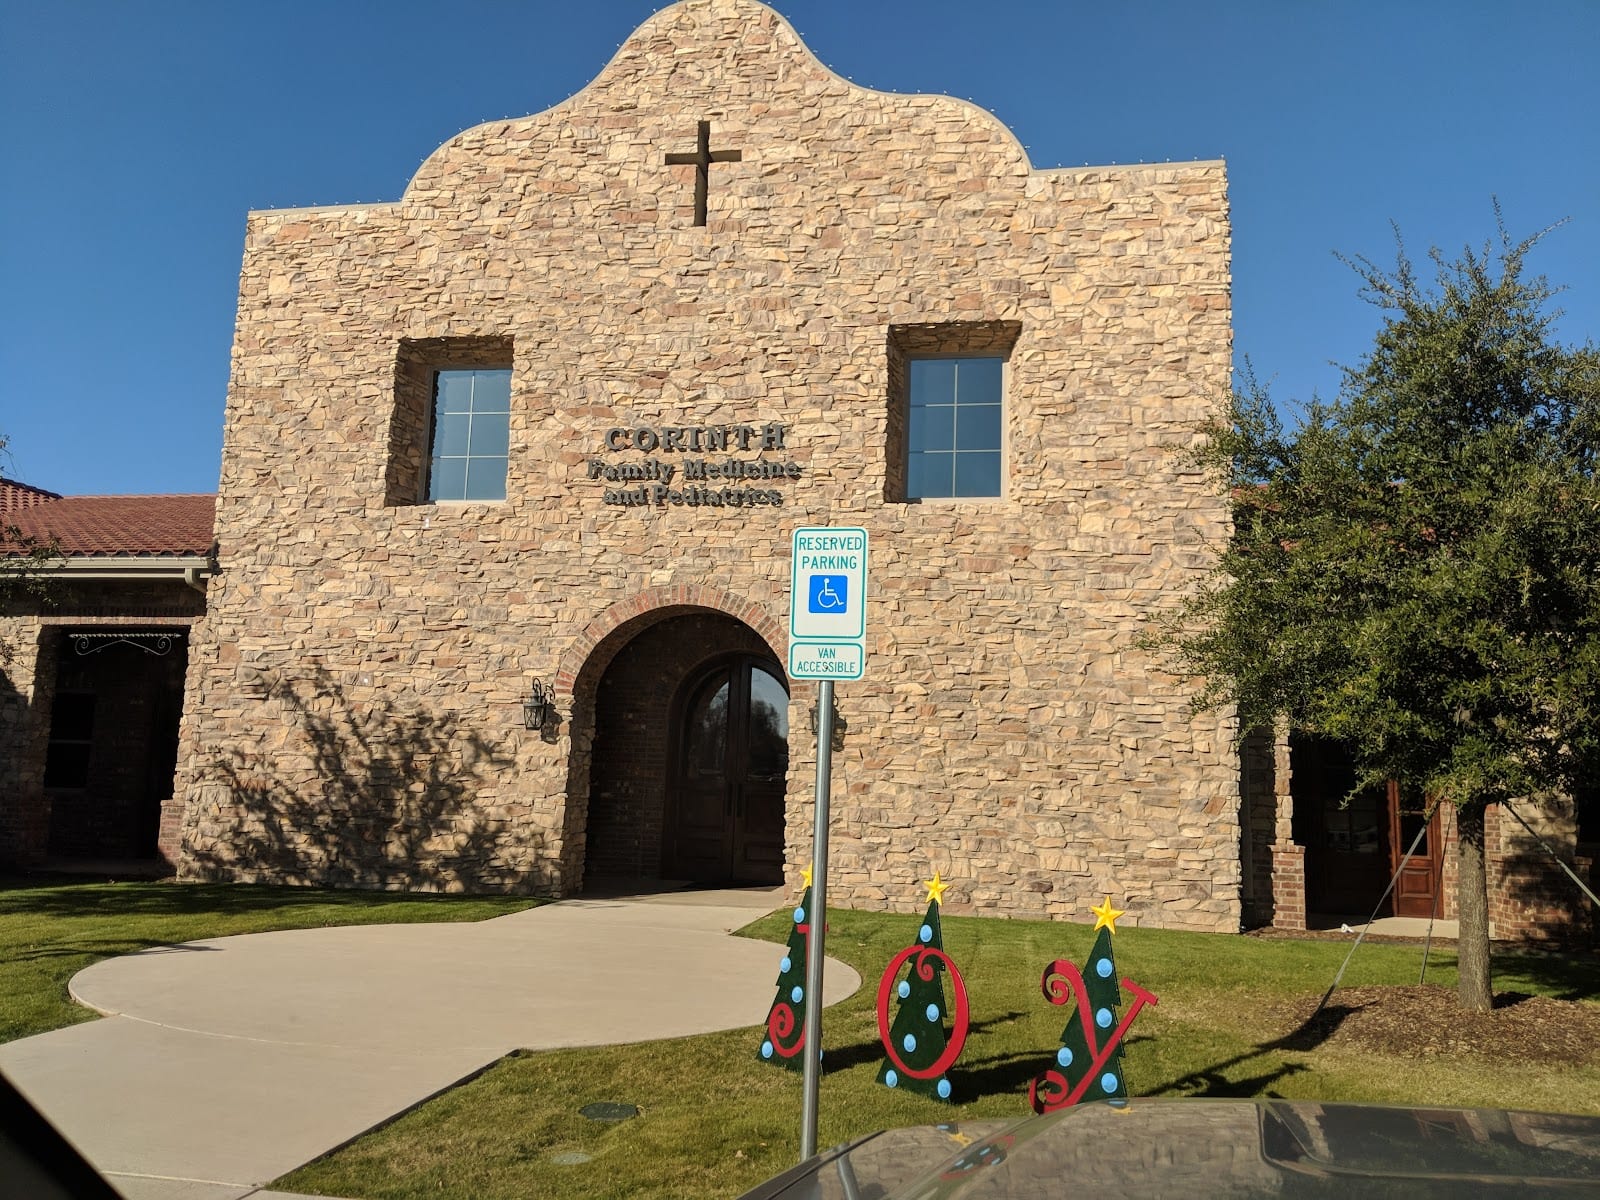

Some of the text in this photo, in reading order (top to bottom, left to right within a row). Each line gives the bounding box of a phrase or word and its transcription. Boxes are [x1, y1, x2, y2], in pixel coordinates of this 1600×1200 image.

[604, 424, 786, 452] CORINTH
[587, 458, 802, 485] Family Medicine
[603, 484, 782, 507] and Pediatrics
[799, 536, 862, 551] RESERVED
[802, 555, 857, 570] PARKING
[817, 647, 836, 659] VAN
[797, 661, 855, 673] ACCESSIBLE
